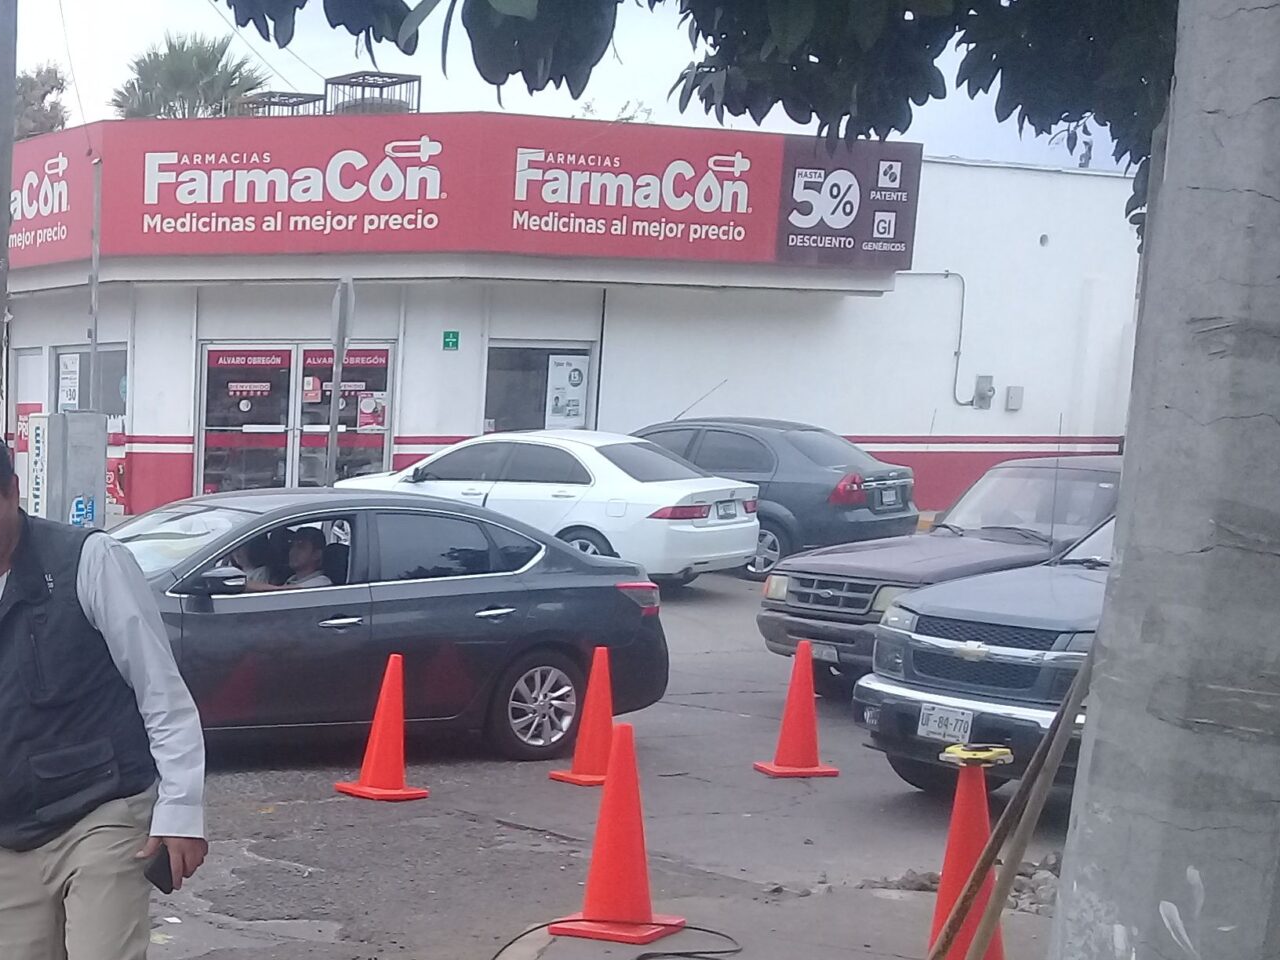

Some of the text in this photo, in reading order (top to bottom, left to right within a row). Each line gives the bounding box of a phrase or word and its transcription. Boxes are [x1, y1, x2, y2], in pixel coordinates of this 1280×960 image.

[797, 171, 823, 179] HASTA
[788, 168, 860, 229] 50%
[870, 190, 908, 201] PATENTE
[143, 209, 439, 235] Medicinas al mejor precio
[512, 210, 746, 243] Medicinas al mejor precio
[876, 219, 892, 235] GI
[8, 227, 35, 250] mejor
[37, 221, 67, 248] precio
[788, 234, 855, 249] DESCUENTO
[217, 355, 282, 365] ALVARO OBREGÓN
[306, 355, 386, 365] ALVAR OBREGÓN
